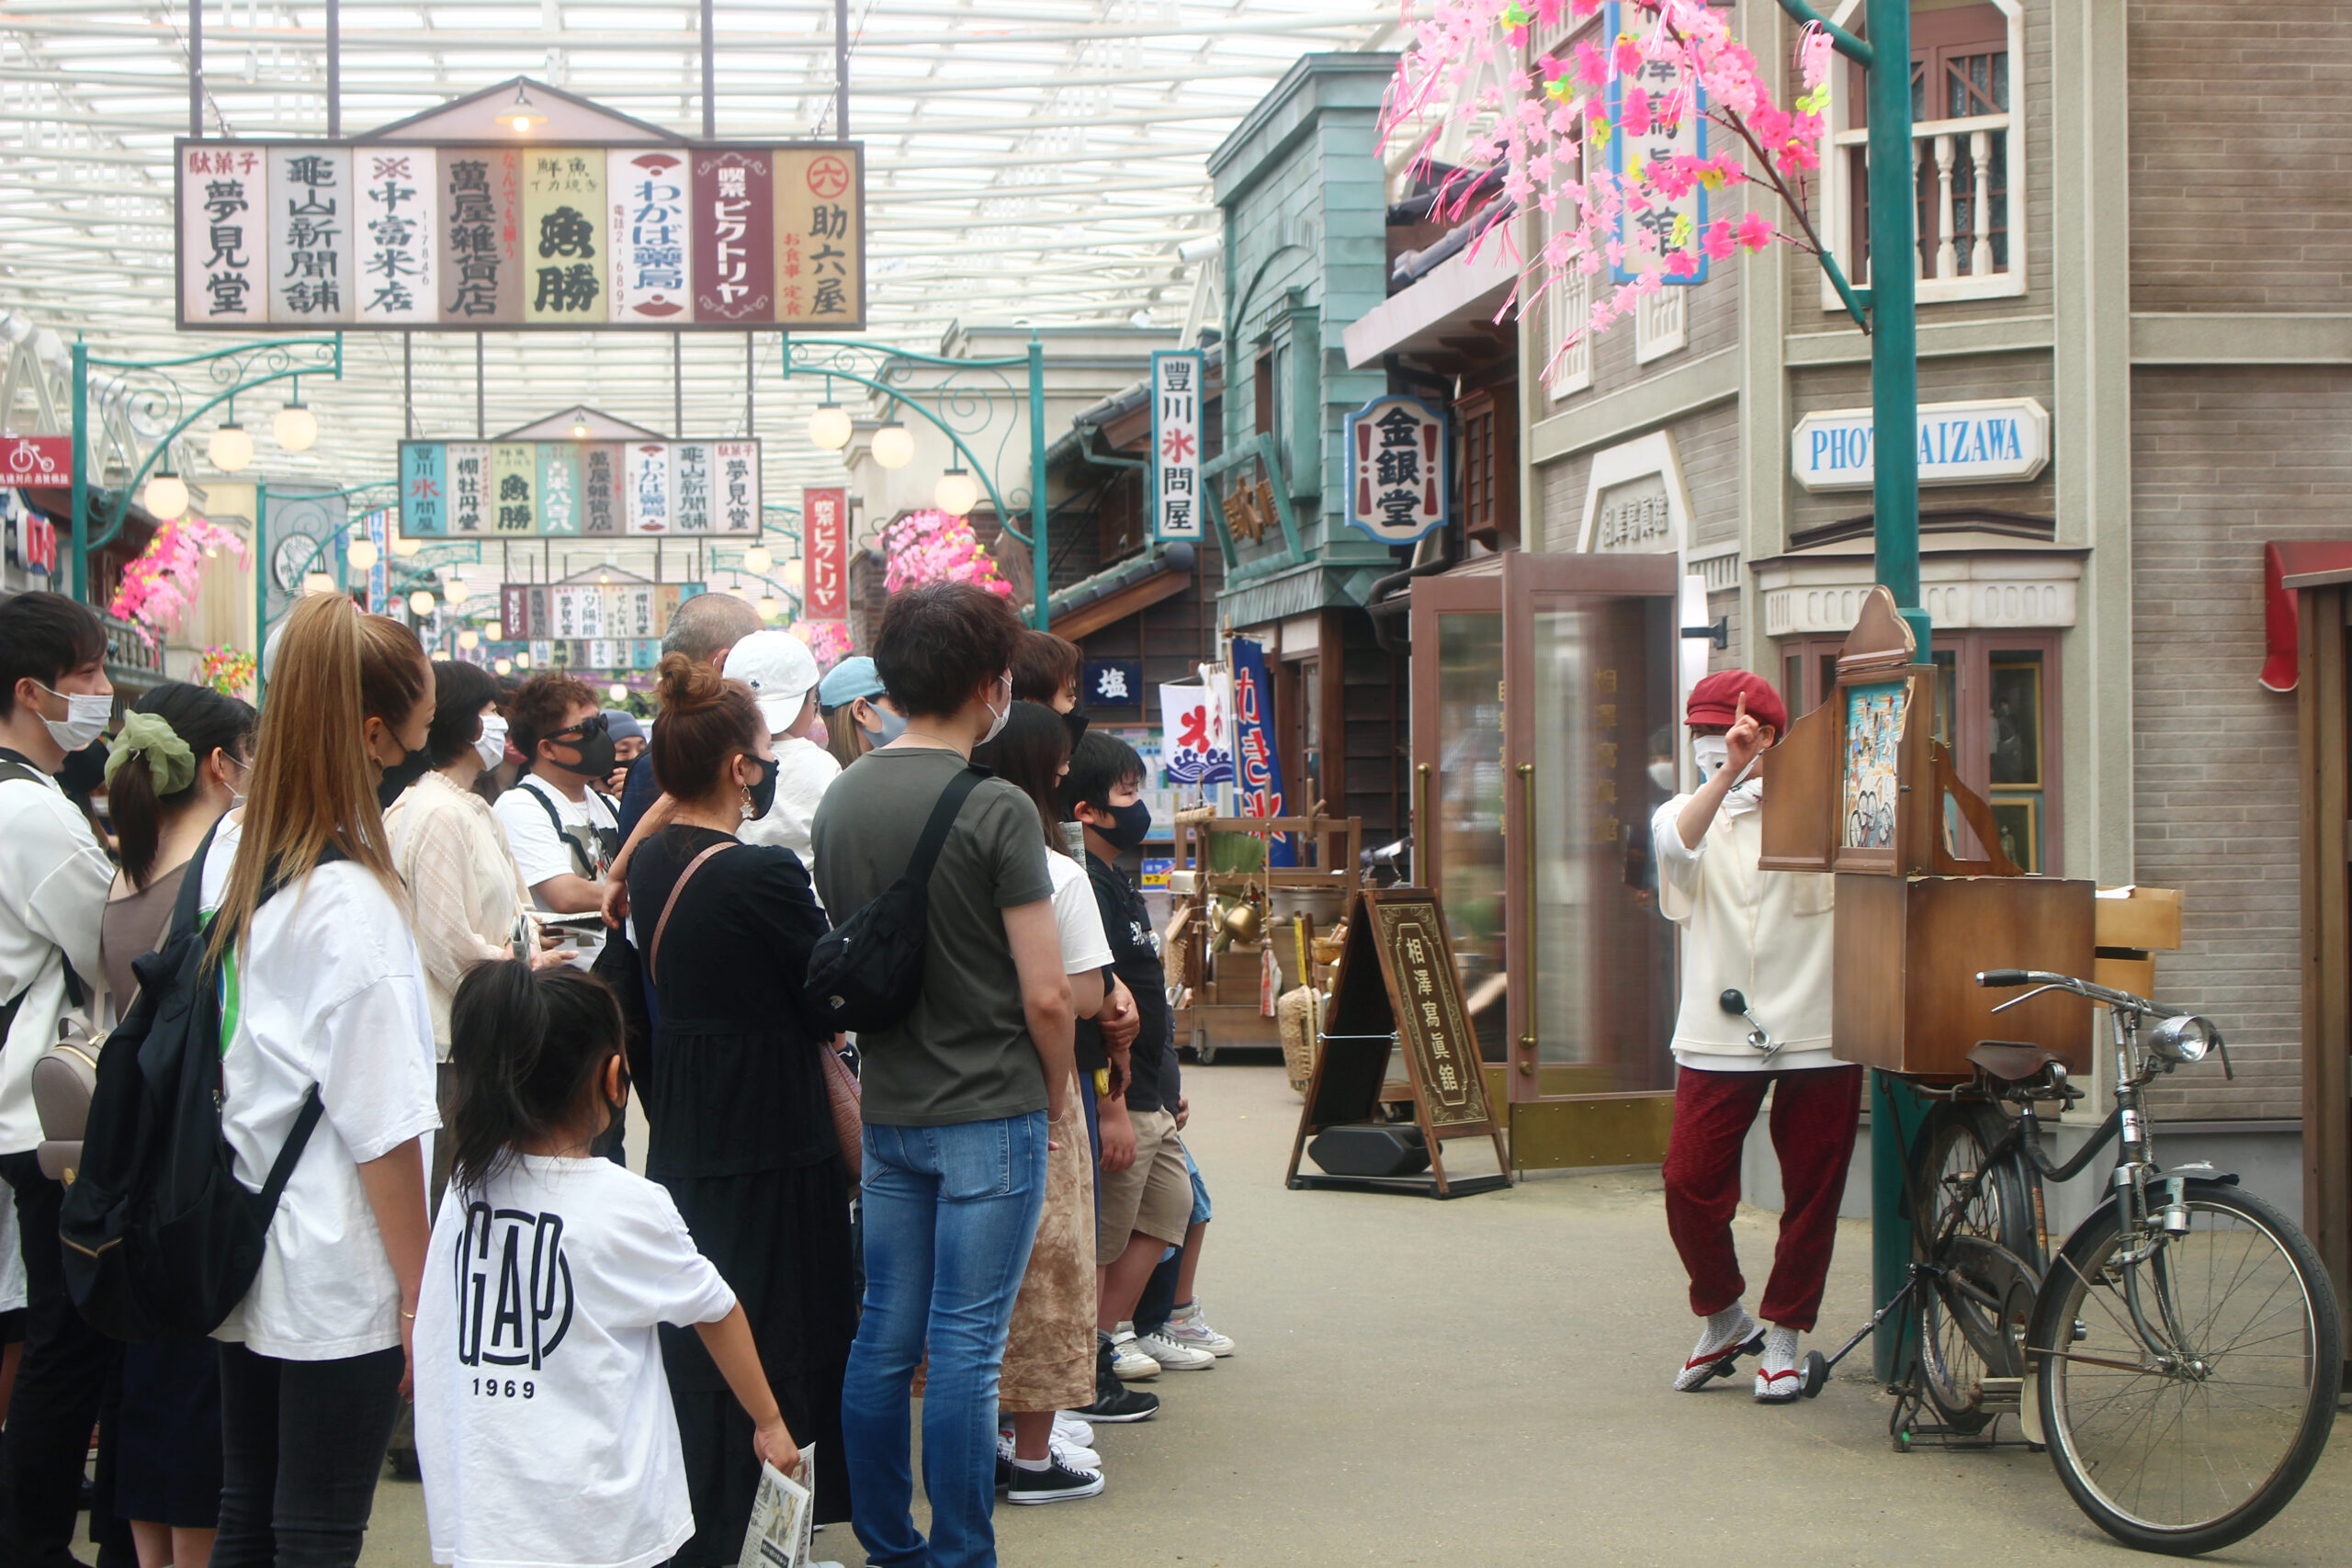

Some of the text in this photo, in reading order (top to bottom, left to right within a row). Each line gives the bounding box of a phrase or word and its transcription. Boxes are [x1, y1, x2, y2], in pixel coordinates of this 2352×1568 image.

[189, 152, 259, 175] 駄菓子
[503, 152, 516, 260] なんでも揃う
[531, 179, 599, 193] イカ焼き
[201, 179, 250, 316] 夢見堂
[534, 206, 600, 312] 魚勝
[714, 167, 751, 304] 喫茶ビクトリヤ
[784, 233, 801, 316] お食事 定食
[808, 203, 849, 316] 助六屋
[718, 446, 754, 457] 駄菓子
[1375, 407, 1421, 528] 金銀堂
[1917, 418, 2023, 465] AIZAWA
[726, 459, 750, 531] 夢見堂
[814, 501, 837, 605] 喫茶ビクトリヤ
[1097, 668, 1129, 698] 塩
[458, 1201, 564, 1371] GAP
[471, 1378, 536, 1400] 1969
